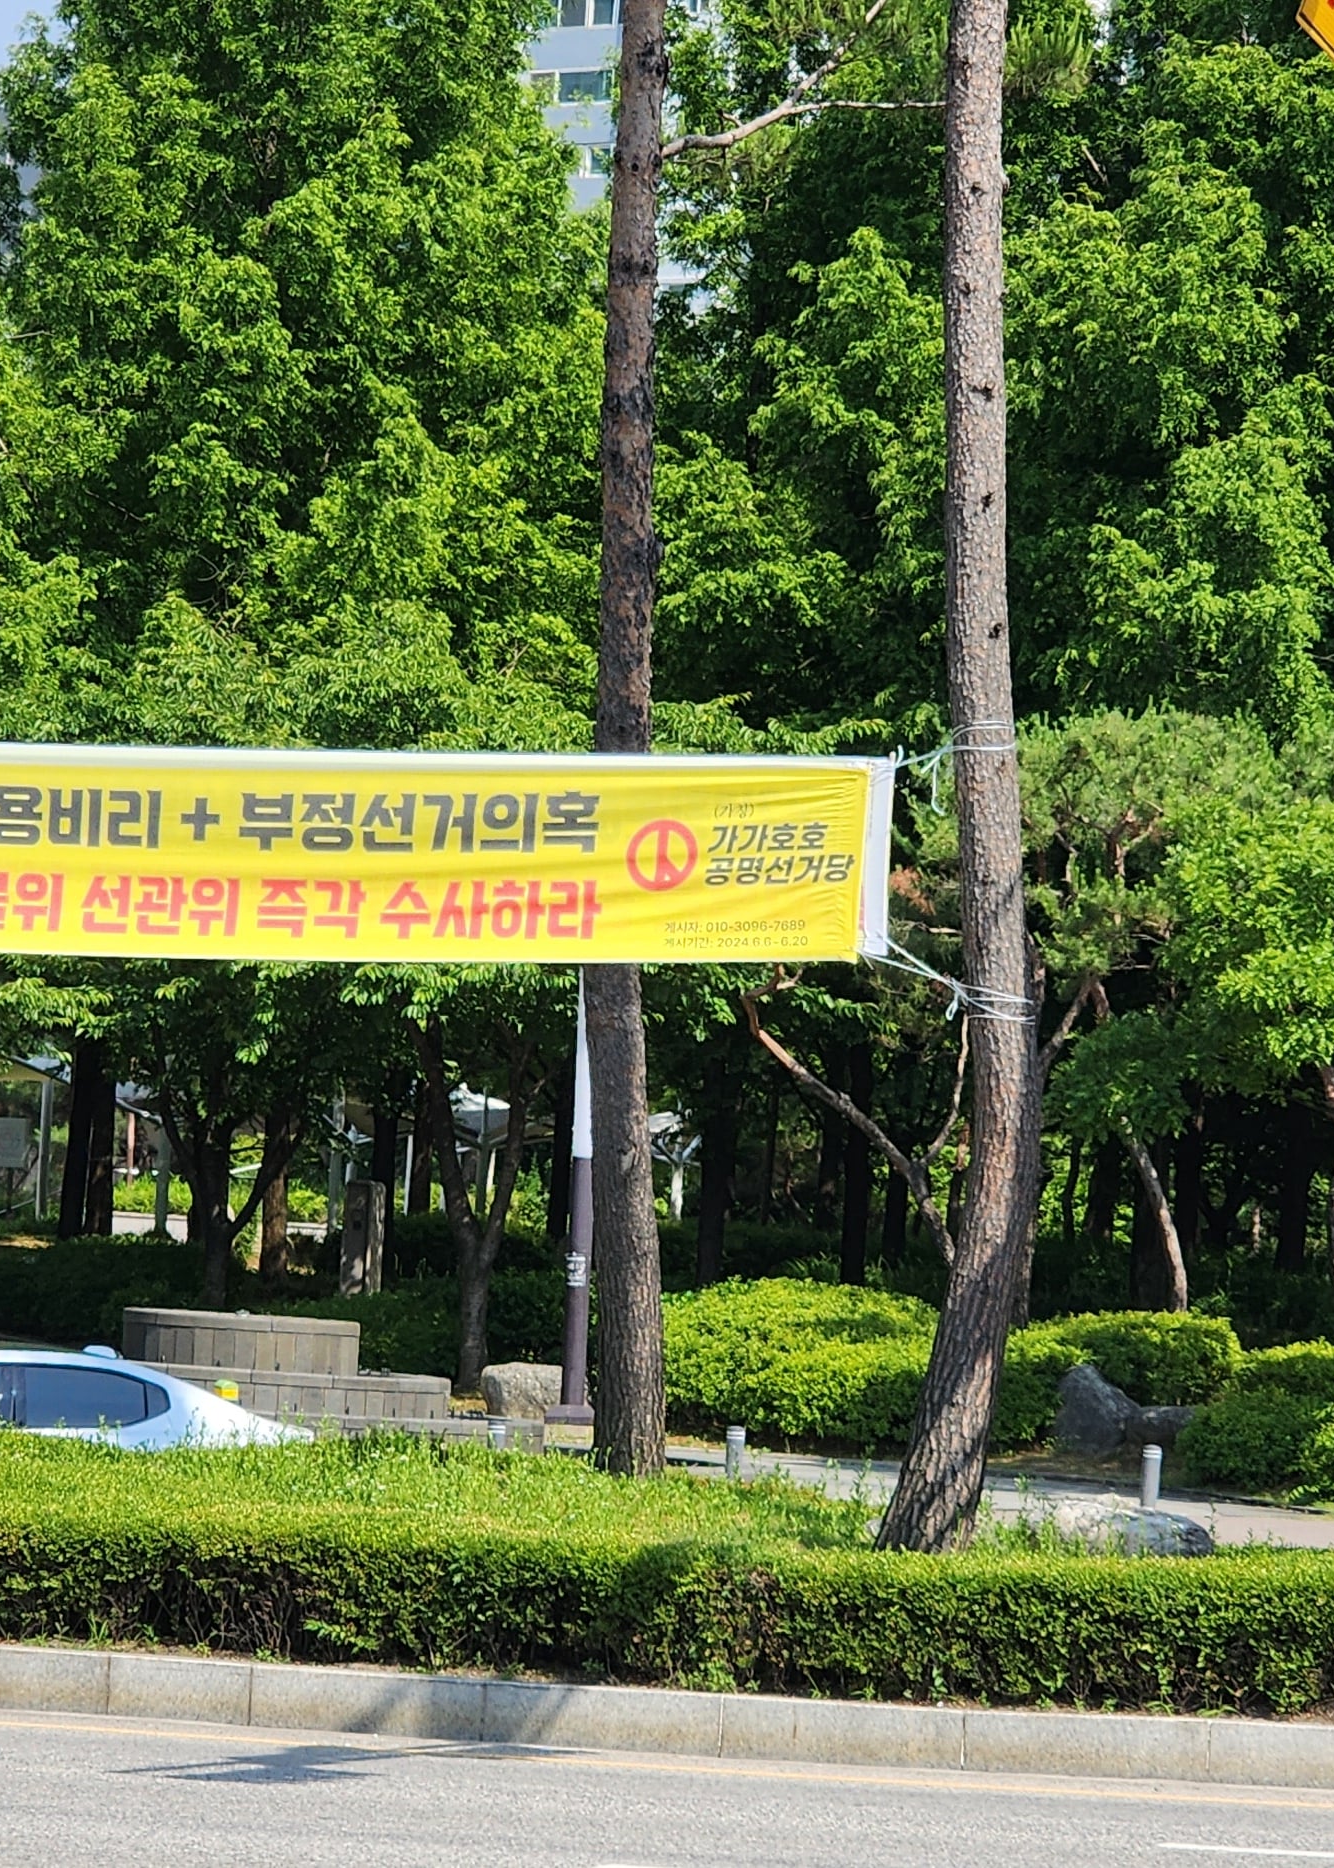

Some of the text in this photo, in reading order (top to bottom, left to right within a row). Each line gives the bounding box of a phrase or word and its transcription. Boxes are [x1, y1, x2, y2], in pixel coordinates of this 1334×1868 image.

[239, 791, 600, 852] 부정선거의혹
[707, 822, 829, 854] 가가호호
[705, 854, 855, 886] 공명선거당
[82, 874, 240, 937] 선관위
[256, 878, 366, 939] 즉각
[380, 880, 602, 940] 수사하라
[706, 919, 806, 933] 010-3096-7689
